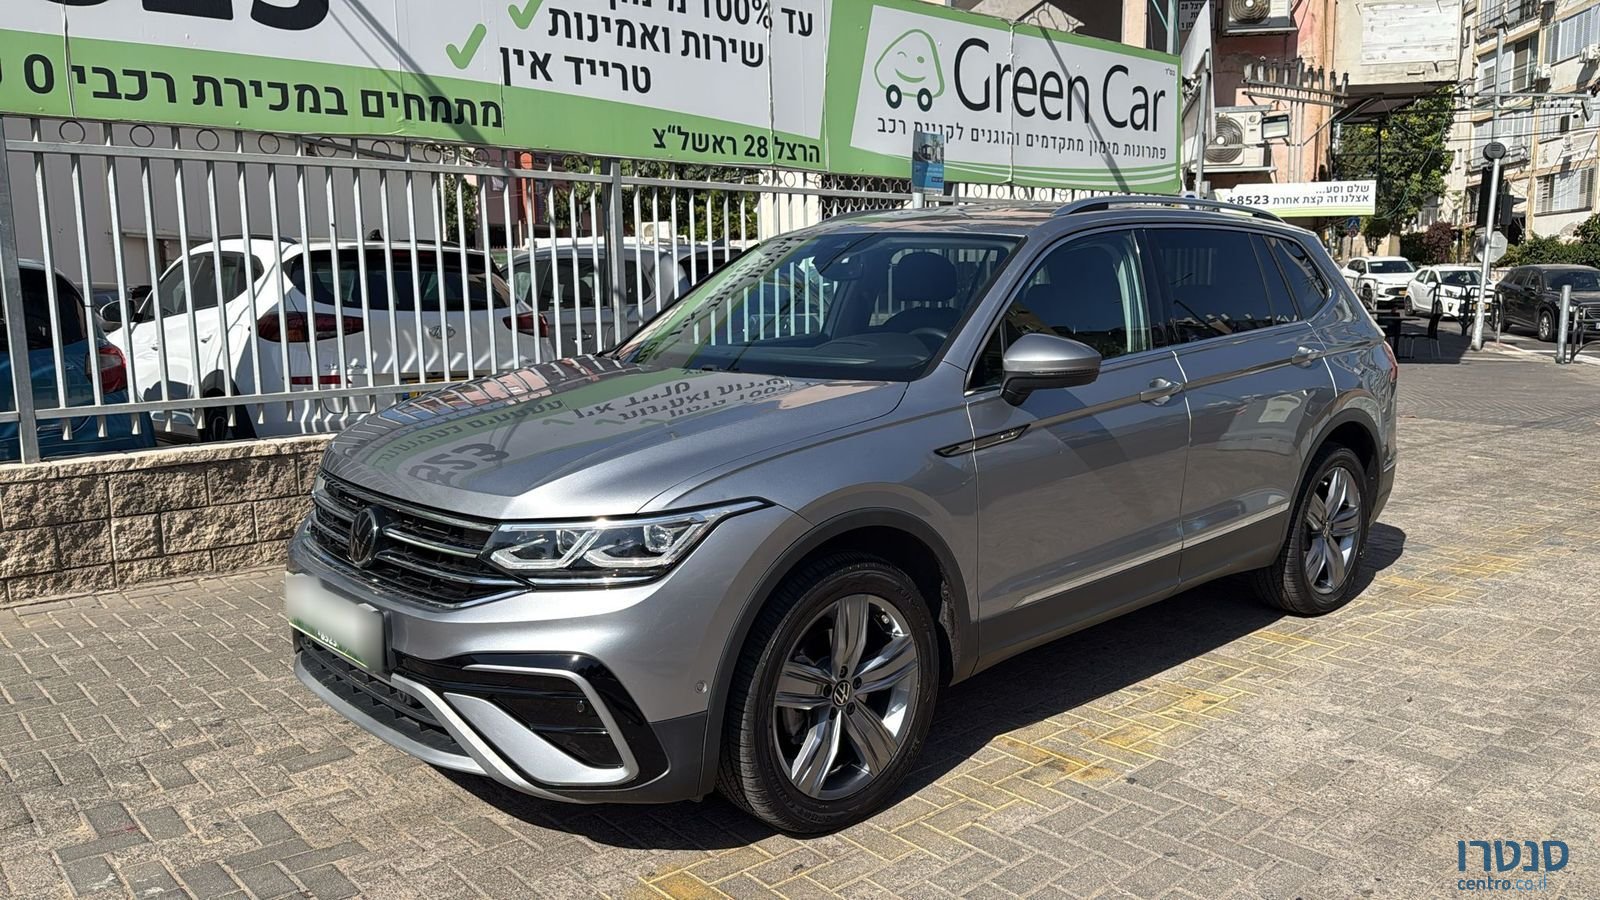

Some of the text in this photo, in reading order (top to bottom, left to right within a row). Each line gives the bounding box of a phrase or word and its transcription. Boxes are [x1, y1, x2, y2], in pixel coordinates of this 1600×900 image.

[781, 7, 814, 37] עד
[548, 7, 764, 68] שירות ואמינות
[23, 53, 55, 95] 0
[500, 46, 652, 94] טרייד אין
[71, 64, 177, 104] רכבי
[954, 37, 1166, 132] Green Car
[192, 74, 349, 116] במכירת
[360, 89, 503, 128] מתמחים
[877, 116, 906, 135] רכב
[651, 124, 820, 163] הרצל 28 ראשל"צ
[970, 127, 1020, 146] והוגנים
[1026, 133, 1084, 154] מתקדמים
[1089, 139, 1120, 157] מימון
[1123, 143, 1167, 160] פתרונות
[1326, 195, 1338, 203] זה
[1341, 193, 1369, 203] אצלנו
[1347, 184, 1370, 193] שלם
[1272, 196, 1300, 205] אחרת
[1302, 196, 1323, 206] קצת
